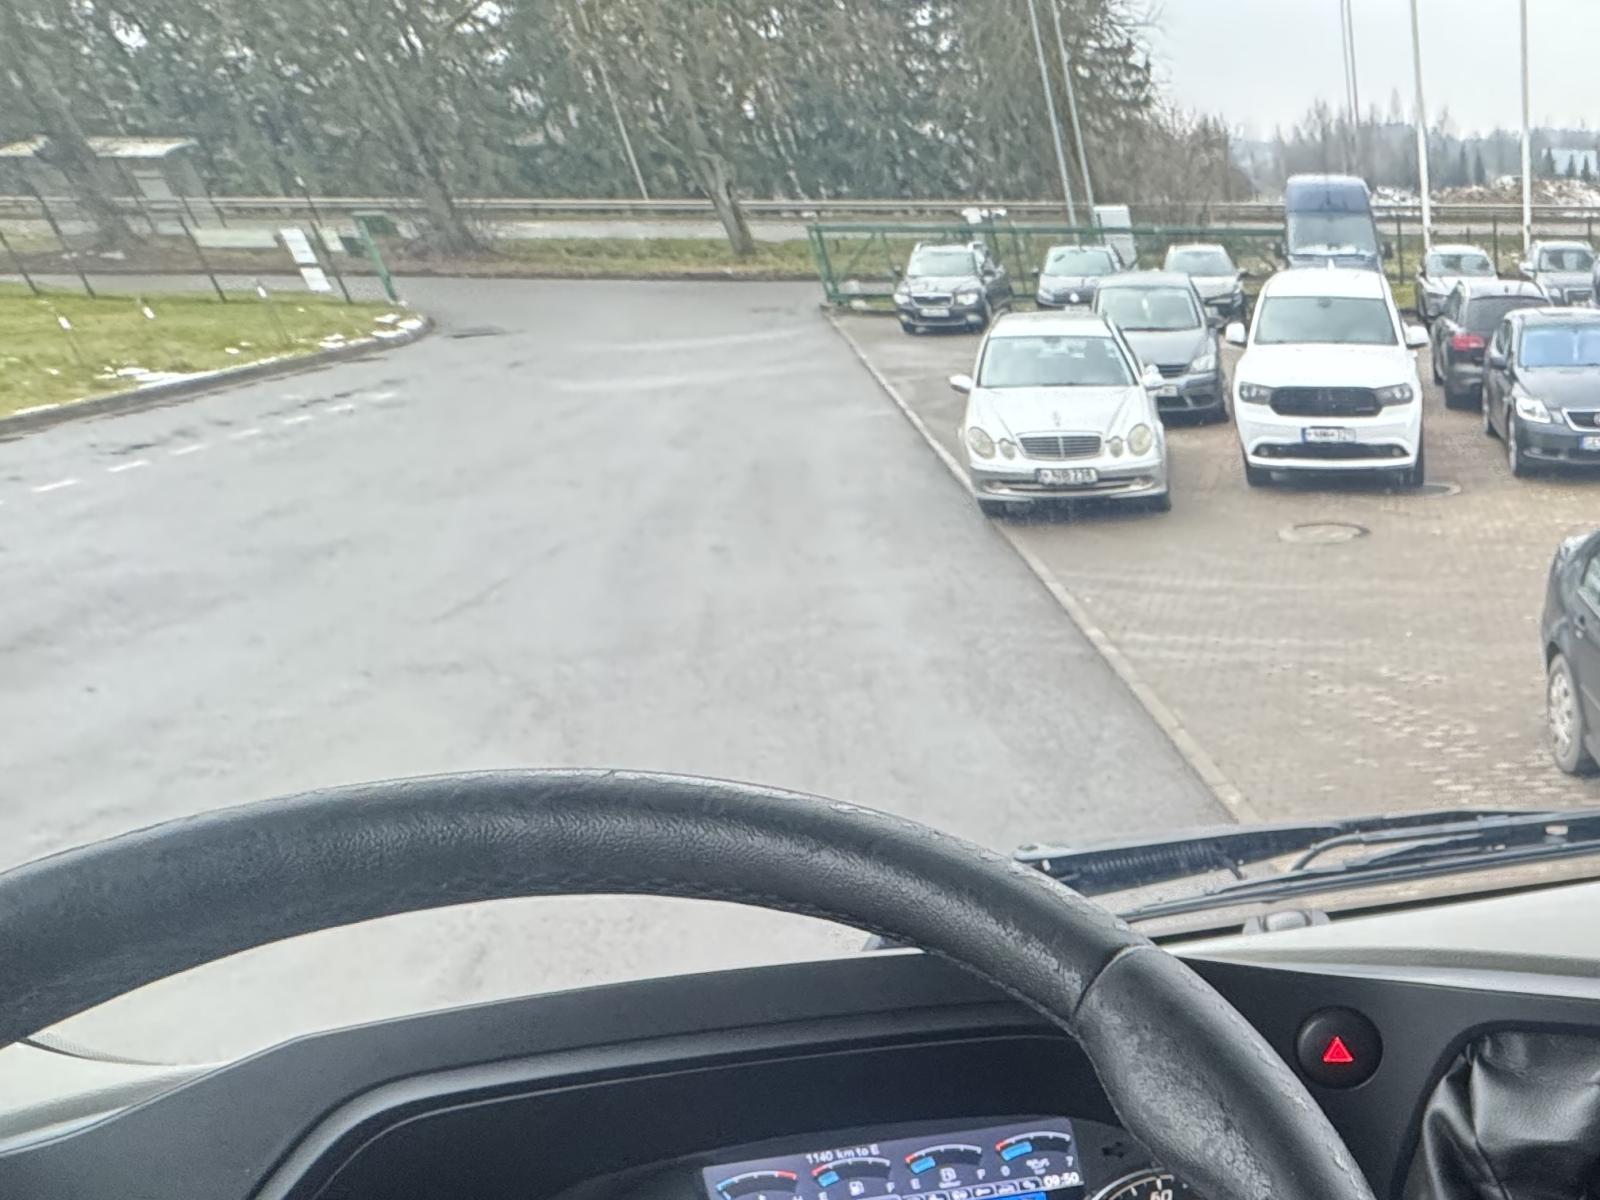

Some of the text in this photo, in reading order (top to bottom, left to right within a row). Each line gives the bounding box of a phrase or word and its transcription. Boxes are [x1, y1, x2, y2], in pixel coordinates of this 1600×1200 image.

[805, 1151, 834, 1165] 1140
[836, 1148, 855, 1160] km
[1043, 1171, 1080, 1188] 09:50
